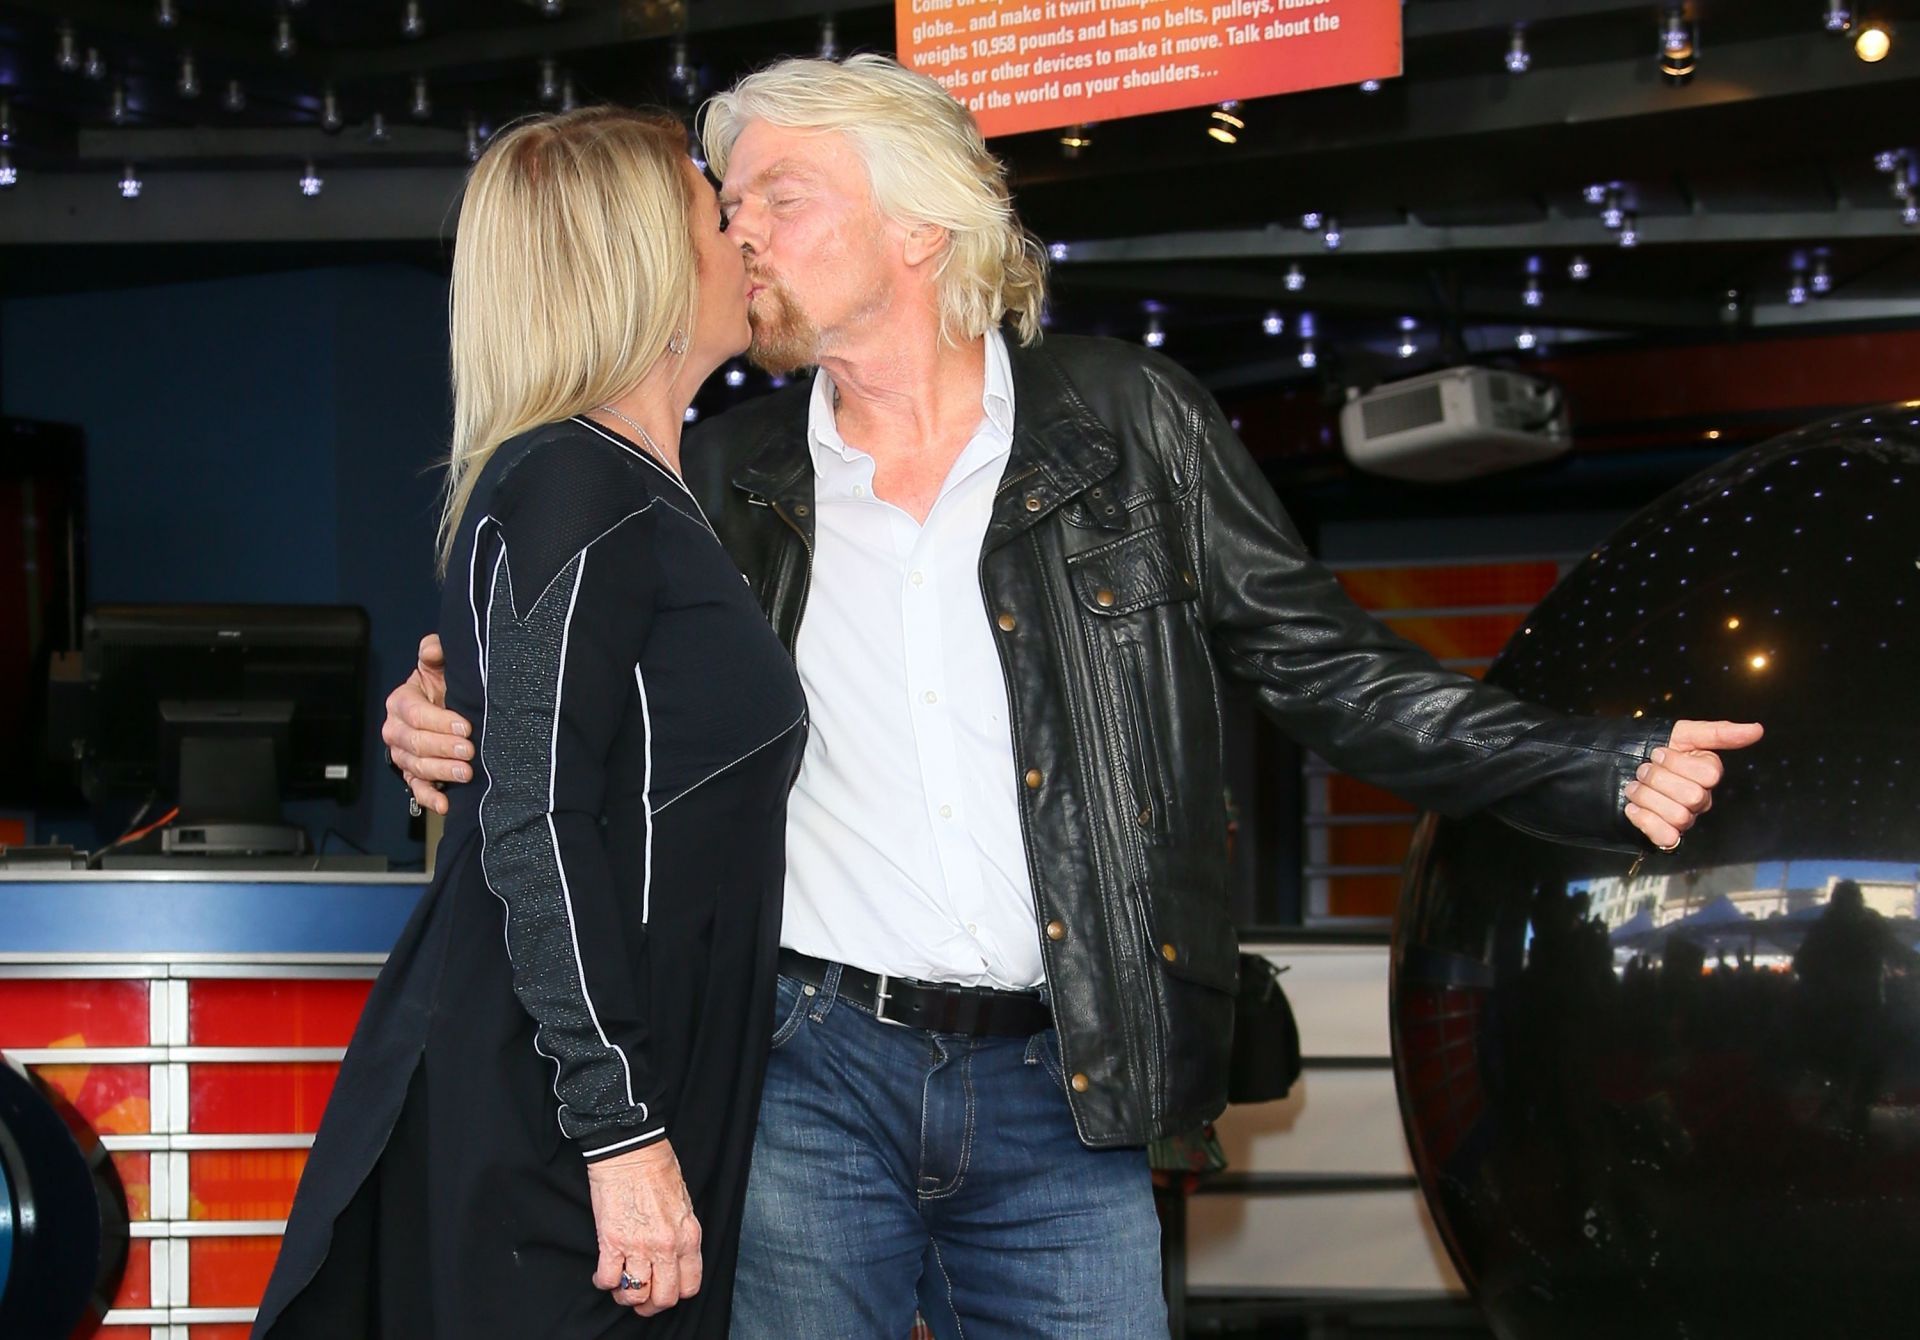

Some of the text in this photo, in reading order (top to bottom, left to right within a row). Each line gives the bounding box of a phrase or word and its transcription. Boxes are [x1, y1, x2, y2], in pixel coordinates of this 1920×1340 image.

[912, 0, 953, 14] Come
[969, 10, 997, 31] and
[1000, 6, 1041, 27] make
[1045, 1, 1056, 19] it
[1059, 0, 1096, 17] twirl
[913, 44, 967, 66] weighs
[971, 34, 1016, 57] 10,958
[1019, 26, 1074, 55] pounds
[1078, 20, 1106, 42] and
[1110, 18, 1138, 36] has
[1142, 16, 1161, 32] no
[1165, 6, 1207, 28] belts,
[1212, 0, 1274, 26] pulleys,
[929, 12, 1340, 88] eels or other devices to make it move. Talk about the
[969, 92, 985, 112] of
[988, 90, 1011, 109] the
[1015, 81, 1059, 105] world
[1063, 82, 1082, 98] on
[1086, 76, 1120, 98] your
